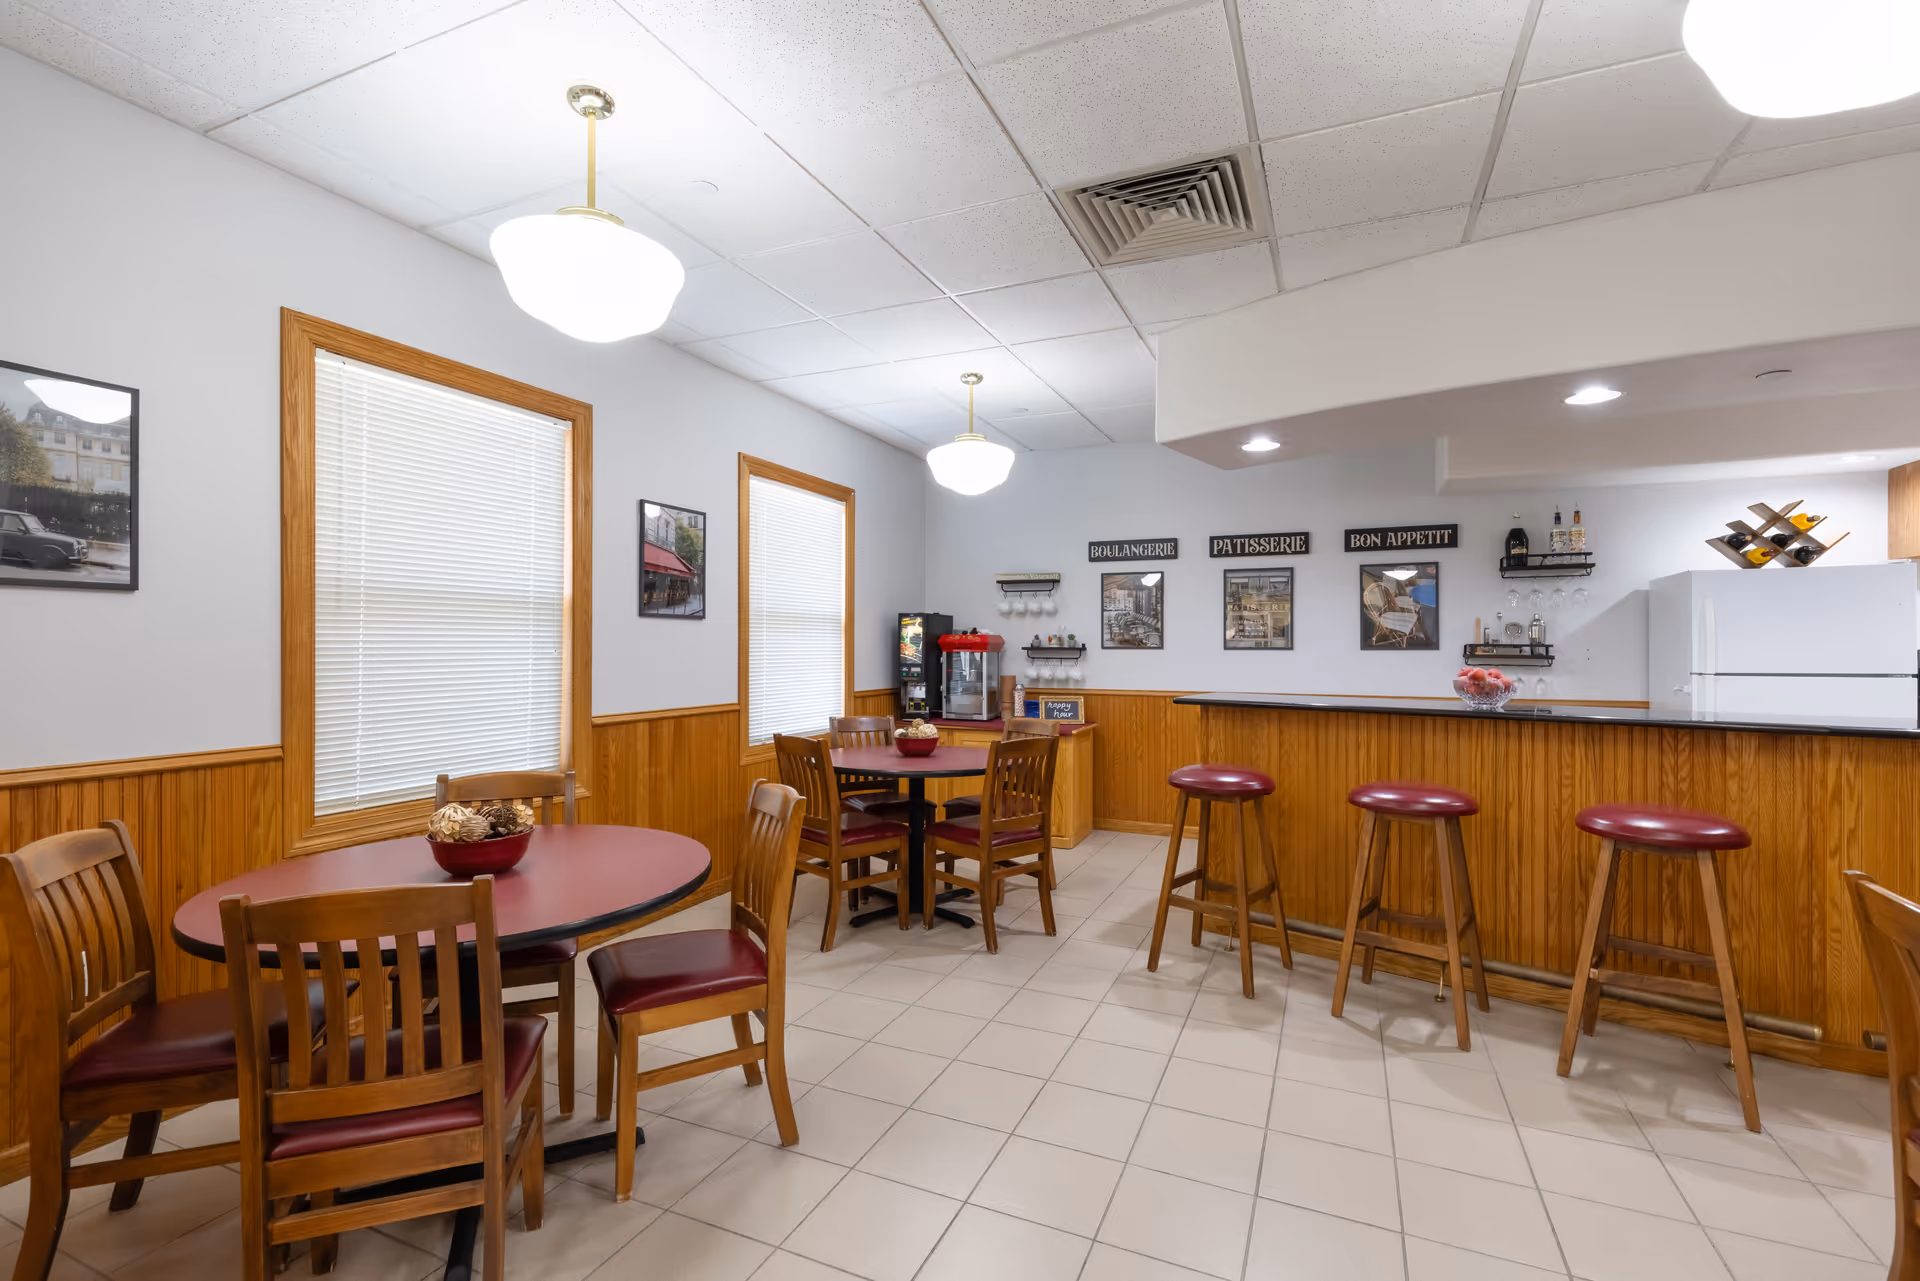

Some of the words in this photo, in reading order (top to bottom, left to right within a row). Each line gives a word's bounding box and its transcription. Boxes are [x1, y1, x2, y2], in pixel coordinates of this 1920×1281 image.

[1213, 535, 1306, 554] PATISSERIE
[1350, 533, 1382, 548] BON
[1386, 529, 1452, 546] APPETIT
[1090, 542, 1175, 558] BOULANGERIE
[1047, 702, 1072, 712] happy
[1053, 709, 1074, 719] hour
